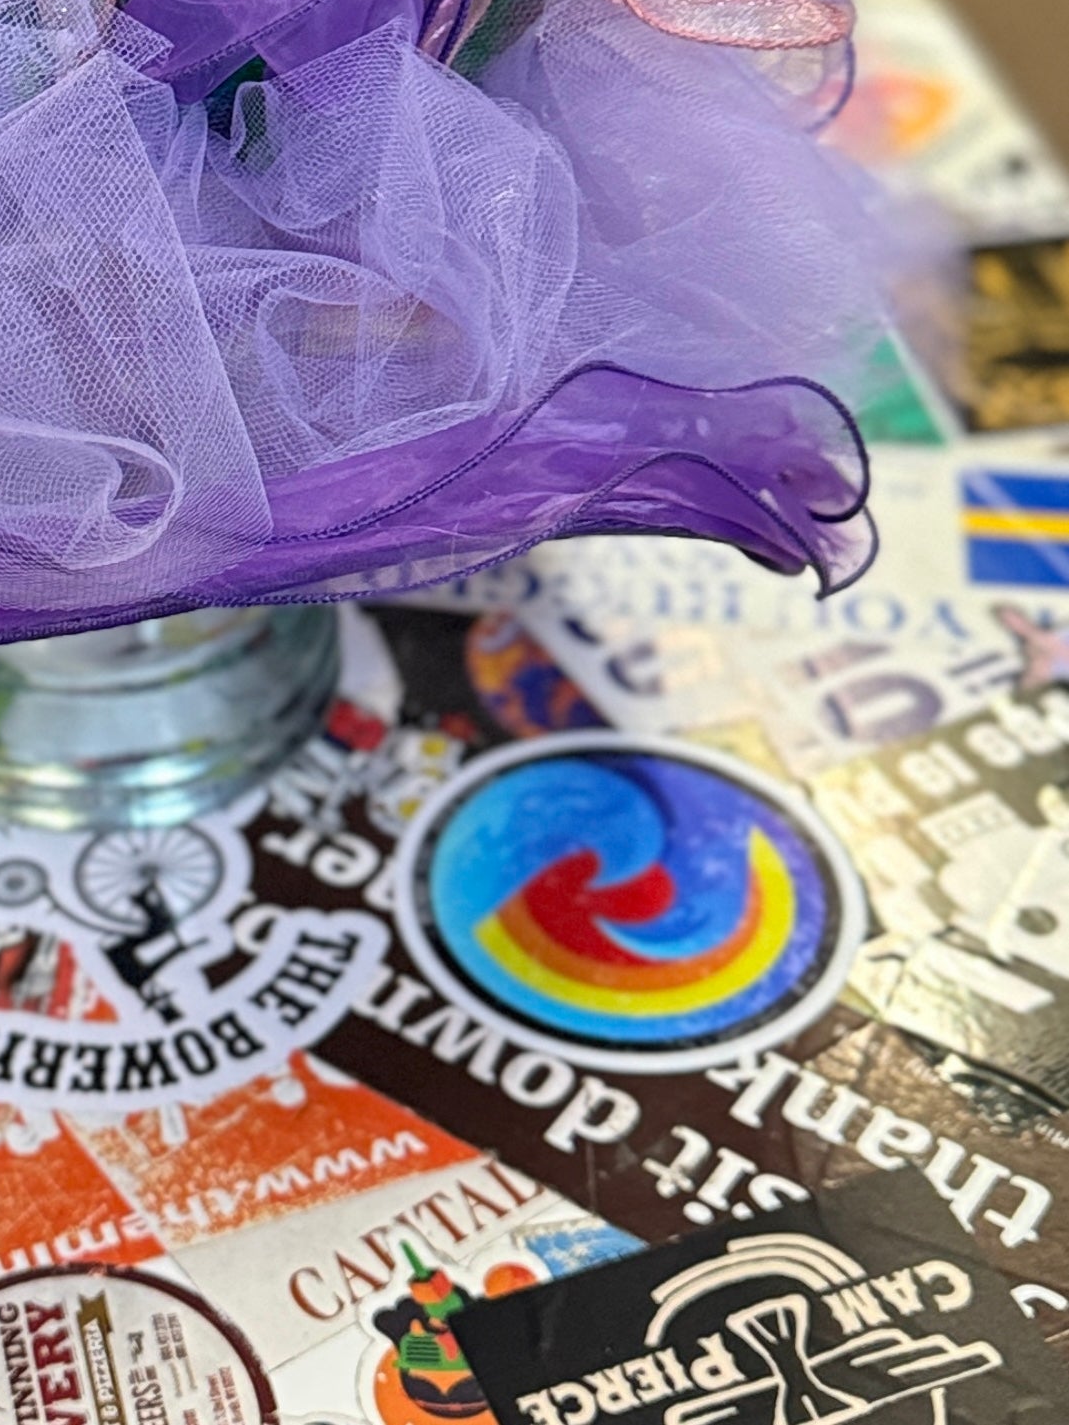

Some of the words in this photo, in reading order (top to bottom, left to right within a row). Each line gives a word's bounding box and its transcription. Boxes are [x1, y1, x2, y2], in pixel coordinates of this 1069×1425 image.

[249, 930, 360, 1029] THE
[352, 966, 641, 1152] down
[706, 1050, 1053, 1248] thank
[818, 1260, 973, 1336] CAM
